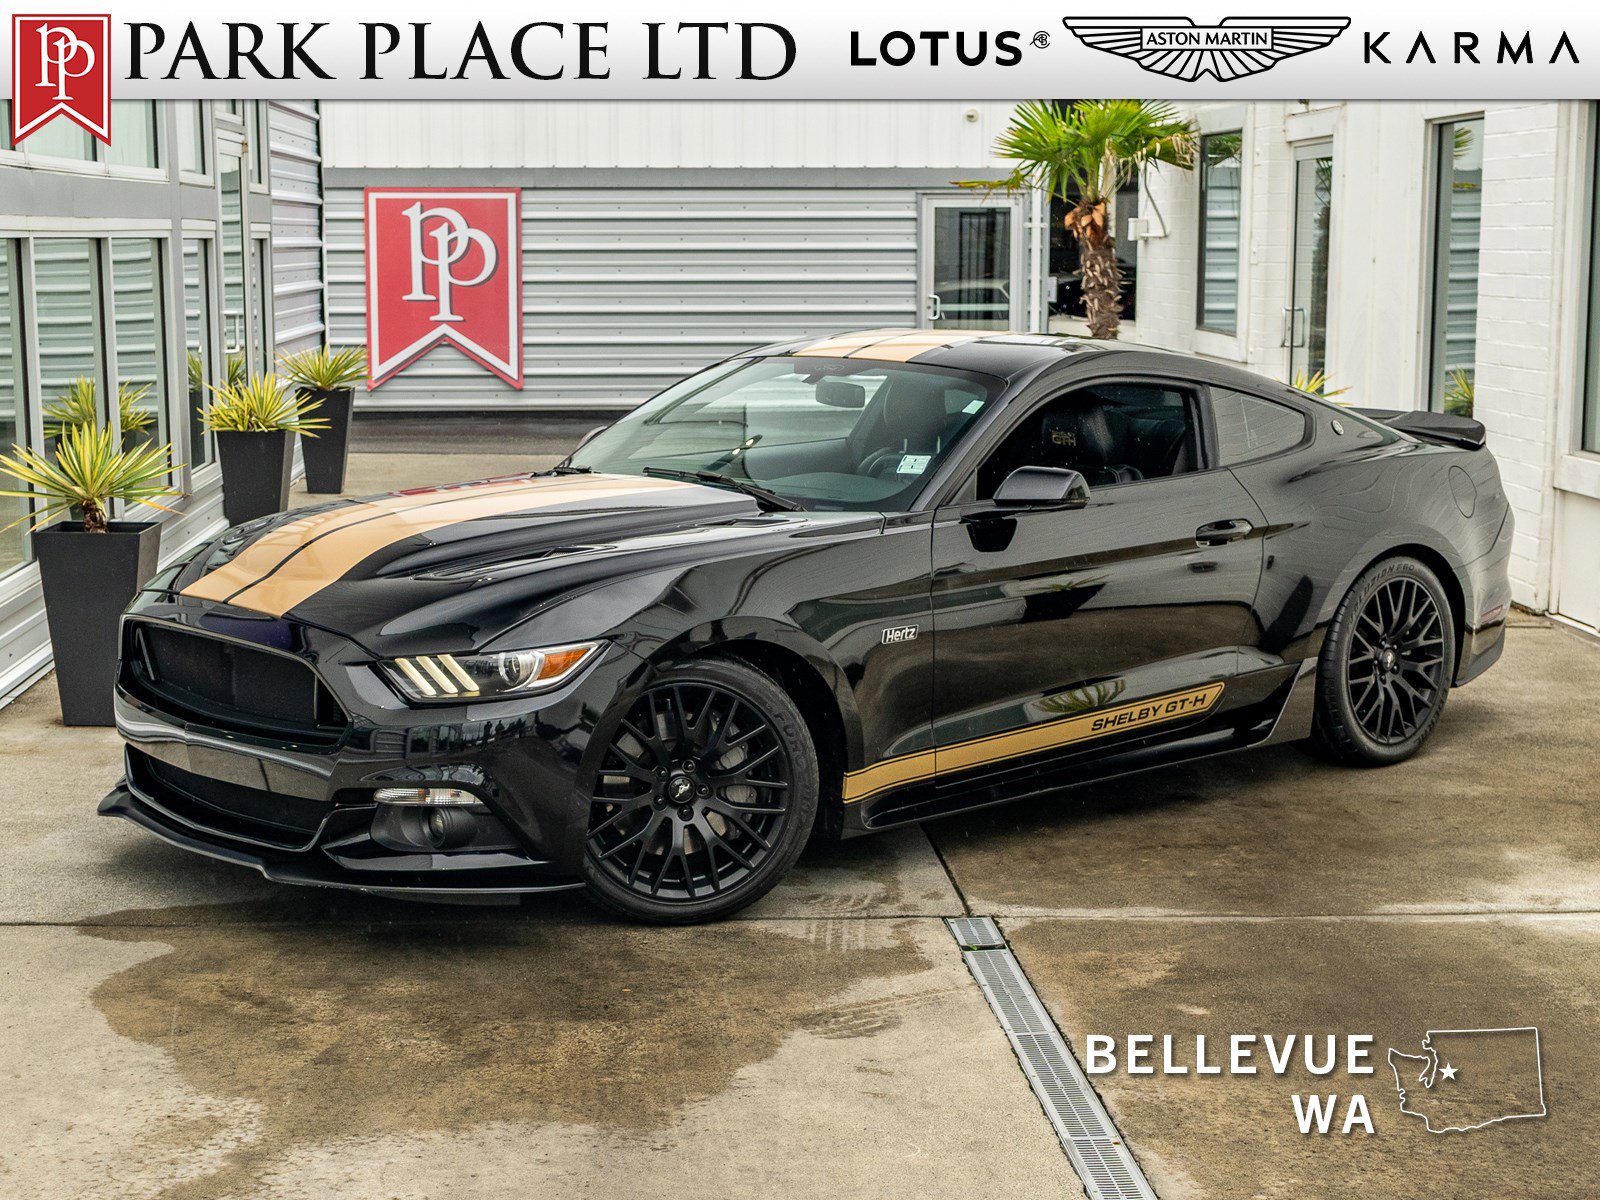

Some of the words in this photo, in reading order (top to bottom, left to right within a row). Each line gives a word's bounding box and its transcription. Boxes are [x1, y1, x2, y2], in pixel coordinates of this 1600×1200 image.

[886, 627, 916, 642] Hertz
[1091, 704, 1162, 732] SHELBY
[1164, 693, 1207, 714] GT-H
